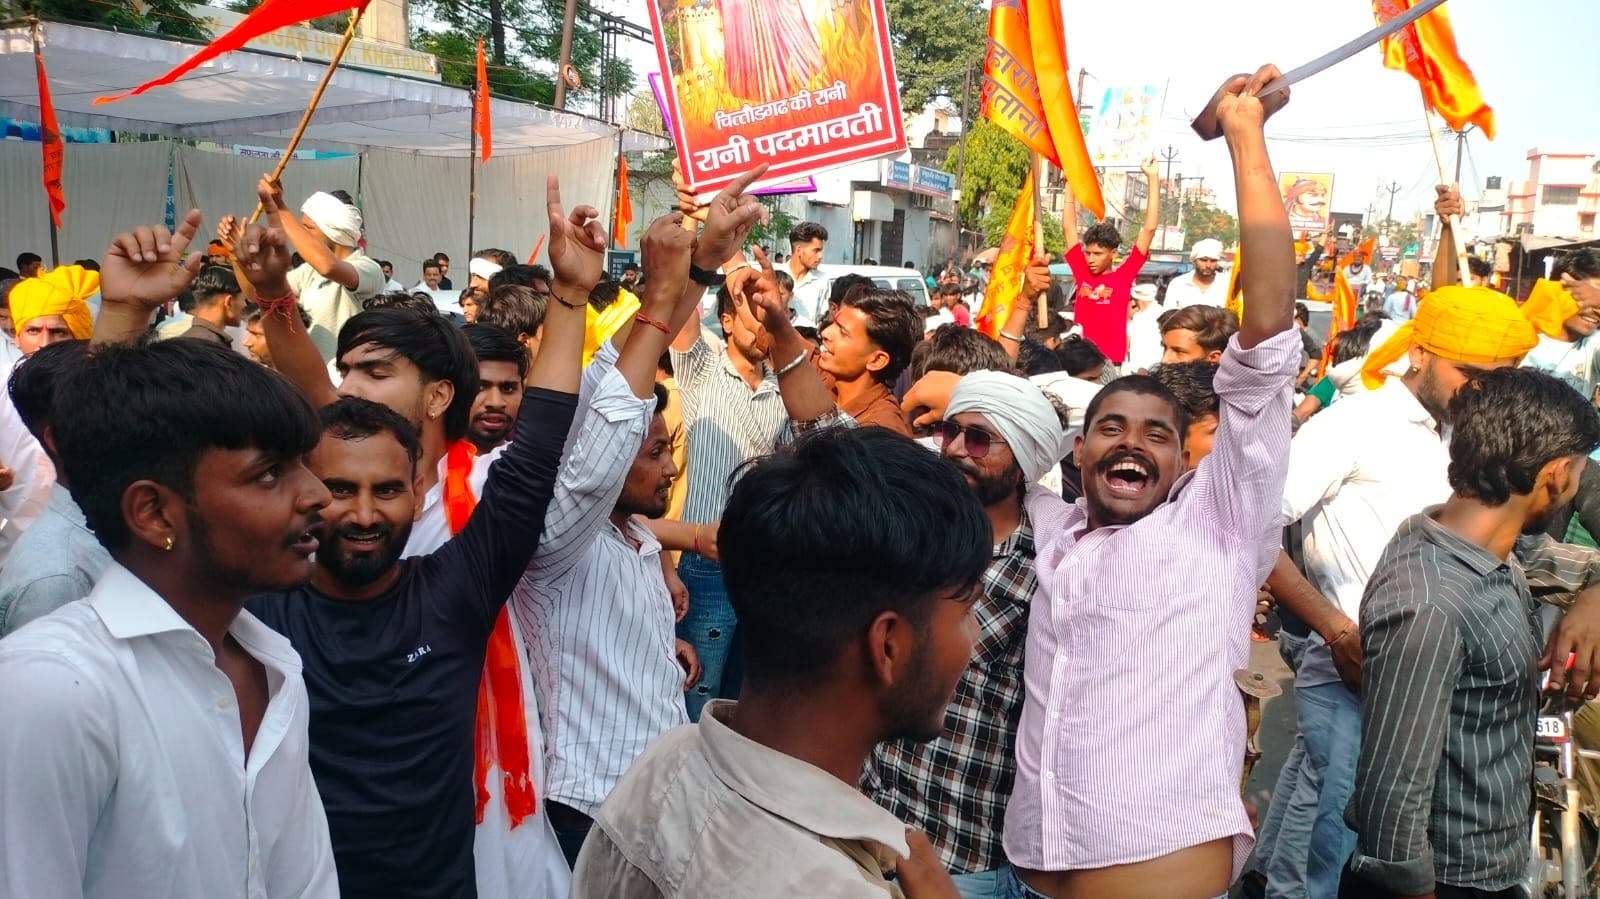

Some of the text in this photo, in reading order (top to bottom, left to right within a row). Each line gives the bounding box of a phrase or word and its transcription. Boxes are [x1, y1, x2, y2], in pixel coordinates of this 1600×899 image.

[788, 91, 812, 111] की
[813, 80, 848, 106] रानी
[693, 102, 883, 172] रानी पदमावती
[407, 644, 432, 663] ZARA
